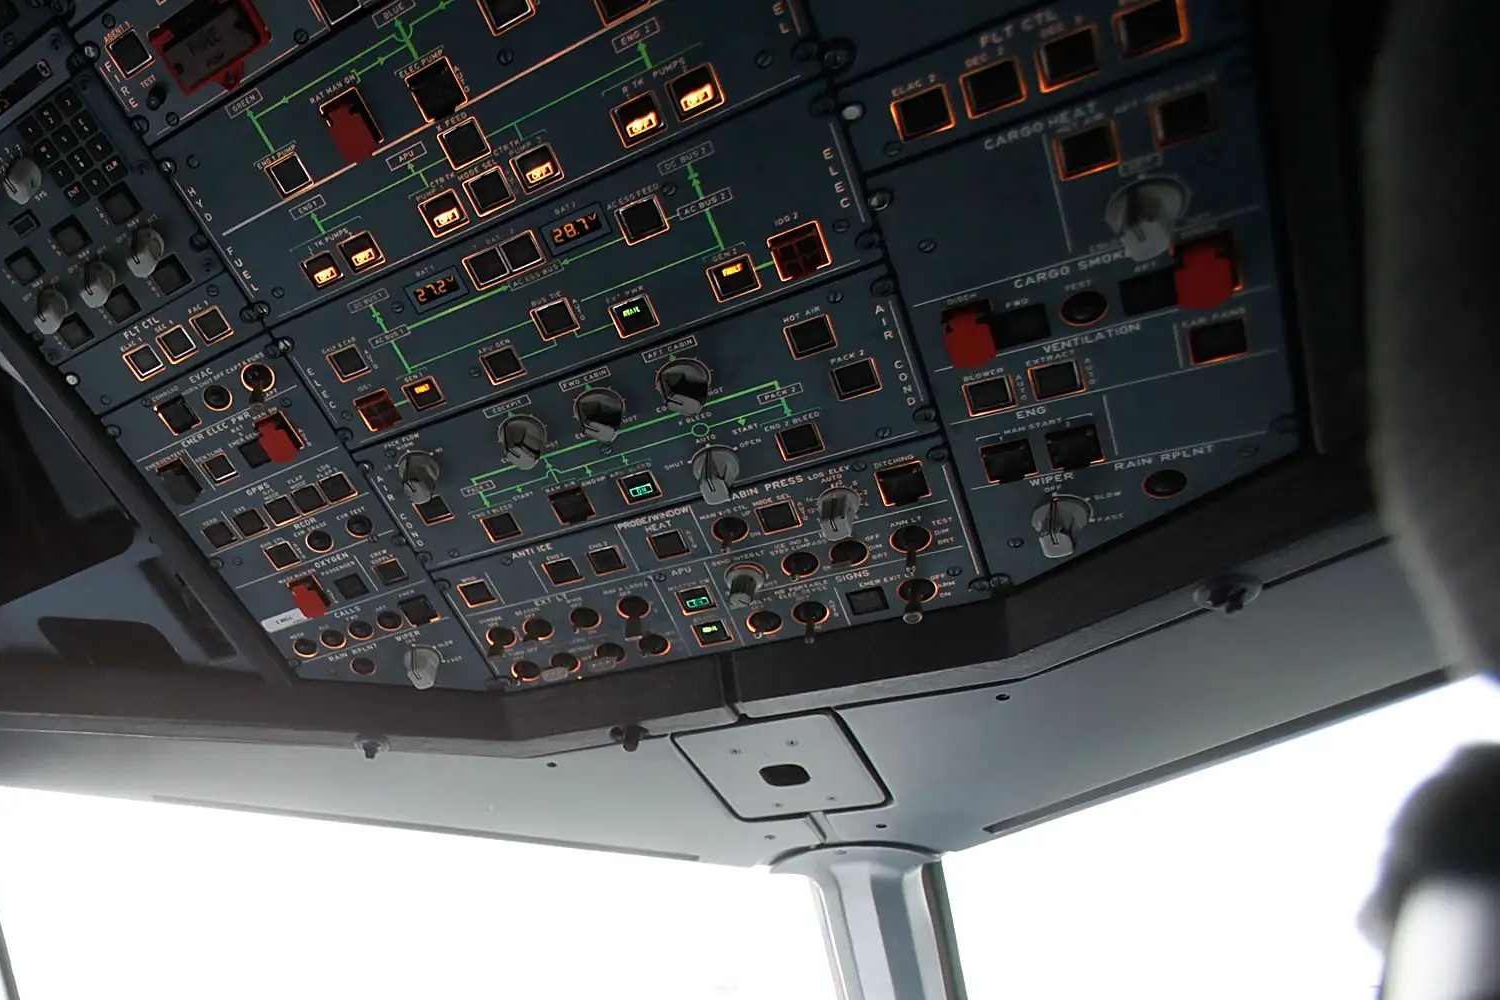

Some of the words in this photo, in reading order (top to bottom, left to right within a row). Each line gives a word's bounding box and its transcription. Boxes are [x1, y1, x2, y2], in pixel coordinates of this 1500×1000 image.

[383, 2, 406, 20] BLUE
[980, 24, 1014, 47] FLT
[1021, 9, 1060, 32] CTL
[620, 29, 642, 45] ENG
[399, 63, 420, 78] ELEC
[419, 49, 444, 66] PUMP
[310, 91, 326, 105] RAT
[326, 82, 342, 96] MAN
[342, 75, 356, 87] ON
[231, 94, 257, 113] GREEN
[686, 91, 711, 106] OFF
[445, 112, 467, 128] FEED
[631, 119, 654, 133] OFF
[984, 122, 1044, 151] CARGO
[1047, 100, 1098, 126] HEAT
[398, 150, 415, 163] APU
[457, 166, 479, 182] MODE
[480, 159, 498, 173] SEL
[531, 166, 553, 180] OFF
[683, 206, 697, 217] AC
[699, 197, 718, 212] BUS
[1013, 264, 1071, 289] CARGO
[1077, 248, 1128, 271] SMOK
[782, 313, 803, 324] HOT
[805, 306, 821, 317] AIR
[874, 305, 895, 341] AIR
[123, 327, 141, 340] FLT
[142, 317, 160, 331] CTL
[1042, 322, 1141, 354] VENTILATION
[647, 350, 664, 360] AFT
[668, 339, 693, 353] CABIN
[1025, 349, 1076, 367] EXTRACT
[190, 367, 213, 383] EVAC
[563, 378, 581, 389] FWD
[583, 368, 607, 383] CABIN
[962, 367, 1005, 382] BLOWER
[893, 360, 916, 406] COND
[491, 400, 522, 414] COCKPIT
[1015, 407, 1047, 420] ENG
[181, 432, 205, 448] EMER
[206, 422, 229, 437] ELEC
[231, 412, 252, 425] PWR
[731, 422, 759, 435] START
[1003, 425, 1025, 435] MAN
[1028, 418, 1063, 431] START
[695, 433, 717, 444] AUTO
[739, 437, 762, 448] OPEN
[664, 460, 685, 471] SHUT
[872, 454, 915, 470] DITCHING
[1114, 457, 1153, 471] RAIN
[1160, 445, 1215, 462] RPLNT
[807, 471, 826, 481] LDG
[828, 464, 850, 475] ELEV
[820, 474, 842, 484] AUTO
[1029, 472, 1075, 488] WIPER
[246, 482, 270, 497] GPWS
[731, 487, 759, 501] ABIN
[764, 475, 804, 491] PRESS
[1093, 491, 1121, 500] SLOW
[751, 498, 773, 509] MODE
[775, 493, 792, 504] SEL
[293, 517, 317, 530] RCDR
[617, 505, 690, 530] PROBE/WINDOW
[931, 516, 953, 526] TEST
[1097, 513, 1125, 522] FAST
[645, 520, 672, 533] HEAT
[511, 547, 535, 560] ANTI
[536, 543, 553, 554] ICE
[314, 552, 349, 568] OXYGEN
[671, 566, 692, 577] APU
[834, 569, 870, 583] SIGNS
[858, 578, 881, 588] EMER
[883, 574, 902, 584] EXIT
[333, 605, 361, 619] CALLS
[395, 630, 421, 642] WIPER
[328, 651, 348, 662] RAIN
[352, 643, 378, 655] RPLNT
